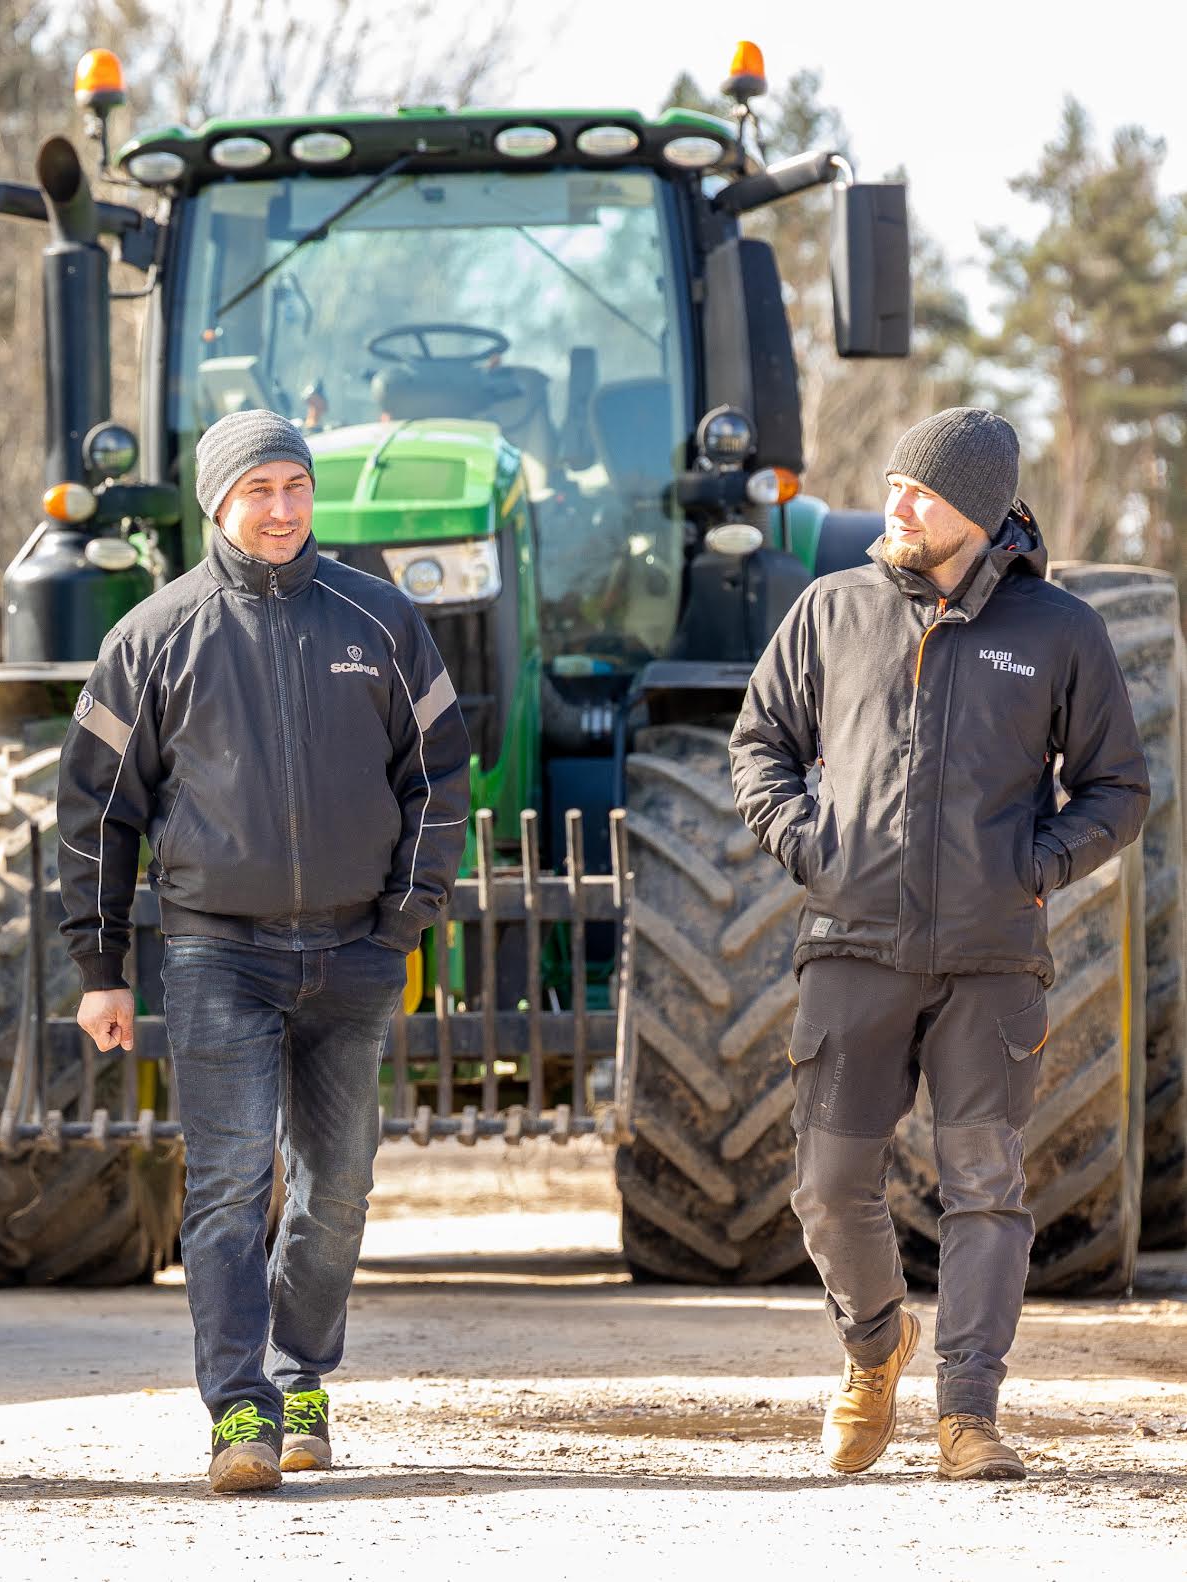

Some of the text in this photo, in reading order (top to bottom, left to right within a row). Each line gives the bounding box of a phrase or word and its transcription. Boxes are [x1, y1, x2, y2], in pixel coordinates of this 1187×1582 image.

[979, 649, 1012, 662] KAGU
[330, 662, 380, 677] SCANIA
[992, 659, 1036, 677] TEHNO
[833, 1052, 846, 1082] HELLY
[825, 1083, 839, 1122] HANSEN
